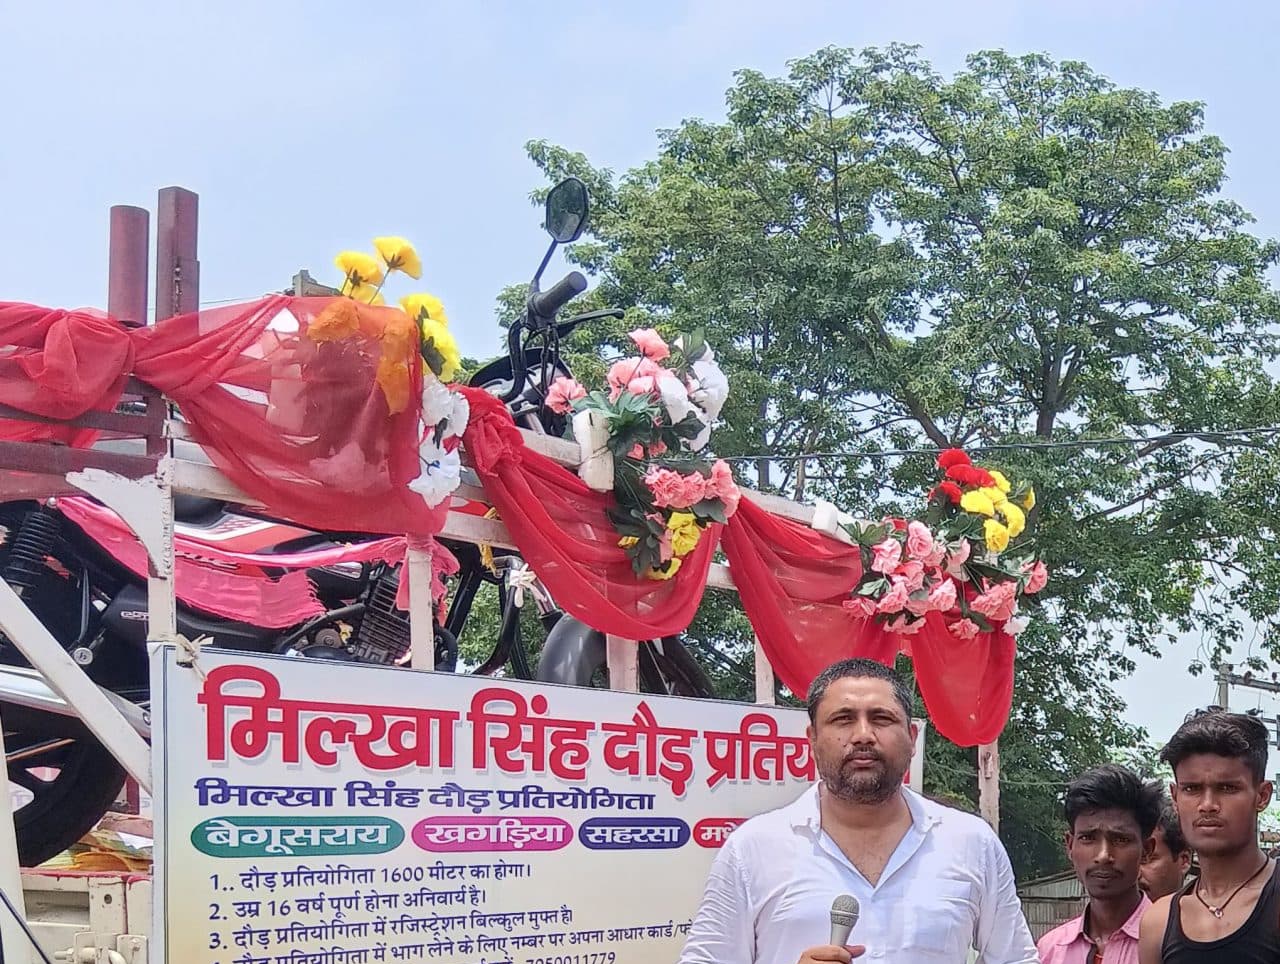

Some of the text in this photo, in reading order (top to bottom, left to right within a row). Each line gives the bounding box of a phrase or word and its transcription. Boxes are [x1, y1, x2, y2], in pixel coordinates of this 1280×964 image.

[198, 664, 697, 796] मिल्खा सिंह दौड़
[194, 778, 655, 814] मिल्खा सिंह दौड़ प्रतियोगिता
[205, 819, 680, 854] बेगूसराय खगड़िया सहरसा
[240, 859, 531, 893] दौड़ प्रतियोगिता 1600 मीटर का होगा।
[209, 886, 466, 920] 2. उम्र 16 वर्ष पूर्ण होना अनिवार्य
[210, 907, 558, 950] 3. दौड़ प्रतियोगिता में रजिस्ट्रेशन बिल्कुल मुफ्त
[373, 942, 387, 961] में
[392, 944, 424, 960] भाग
[427, 935, 453, 957] लेने
[458, 938, 473, 954] के
[477, 933, 509, 955] लिए
[511, 933, 545, 950] नम्बर
[548, 933, 566, 947] पर
[570, 929, 604, 945] अपना
[607, 925, 644, 941] आधार
